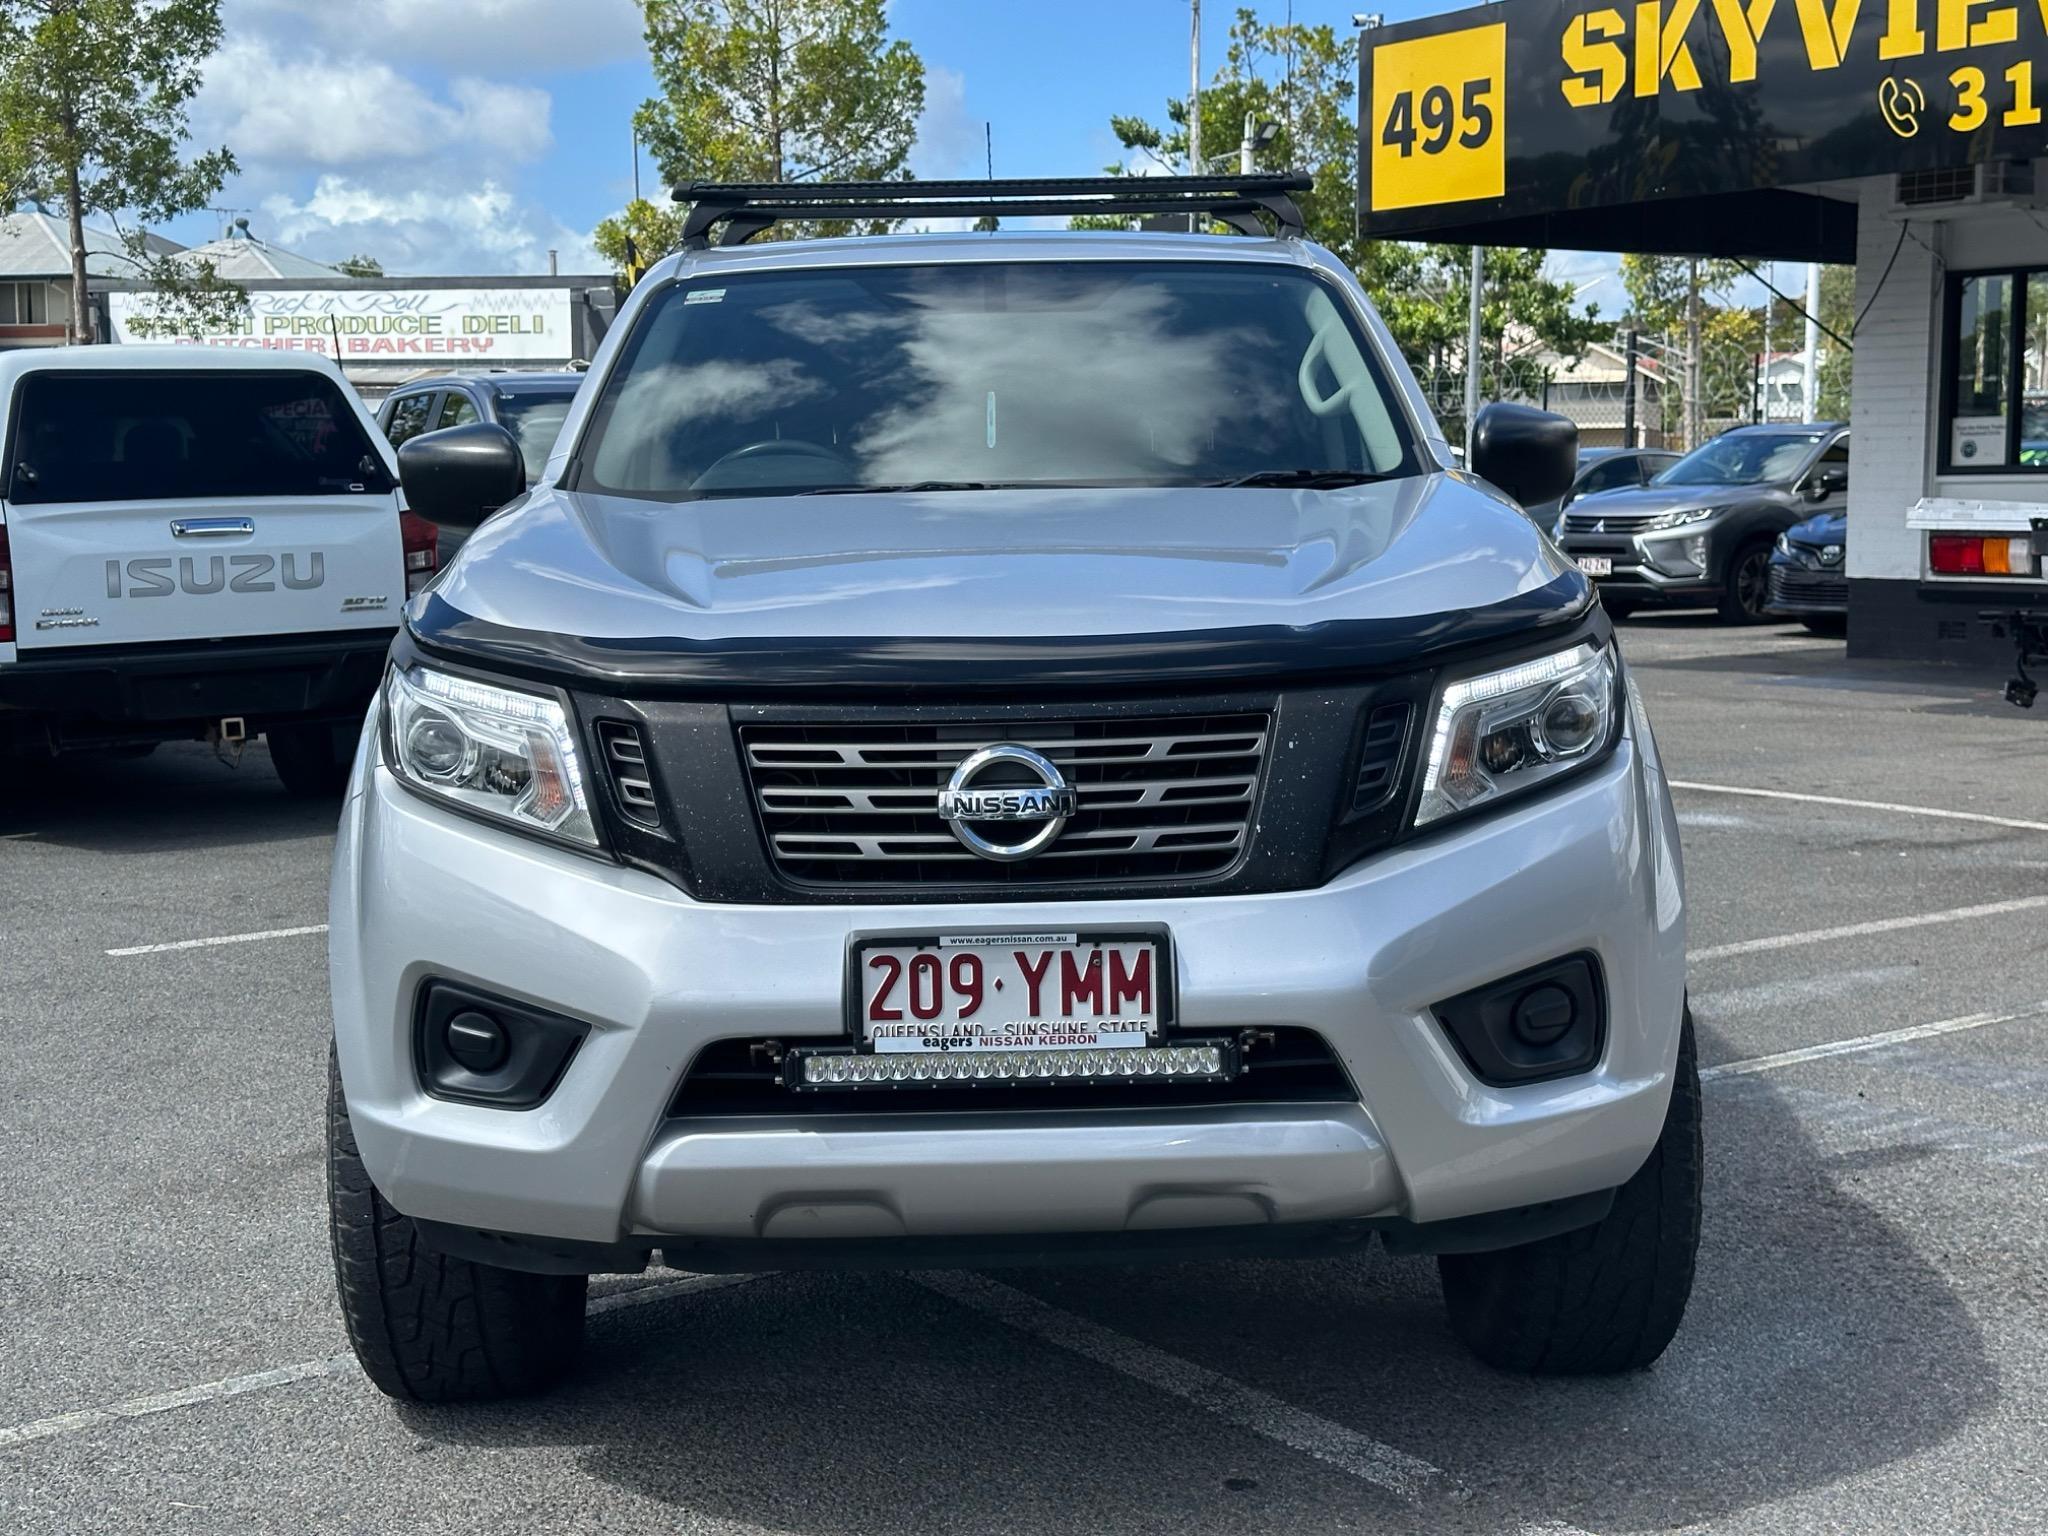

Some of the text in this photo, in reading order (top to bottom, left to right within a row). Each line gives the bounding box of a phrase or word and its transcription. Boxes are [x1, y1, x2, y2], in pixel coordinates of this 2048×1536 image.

[1561, 0, 2048, 108] SKYVIE
[1382, 77, 1494, 159] 495
[251, 292, 312, 315] Rock
[342, 290, 440, 314] Roll
[128, 316, 253, 336] RESH
[348, 337, 494, 353] BAKERY
[105, 551, 325, 598] ISUZU
[953, 795, 1060, 815] NISSAN
[950, 935, 1068, 946] www.eagersnissan.com.au
[868, 948, 1152, 1021] 209 YMM
[872, 1023, 985, 1037] QUEENSLAND
[1003, 1021, 1089, 1036] SUNSHINE
[1097, 1019, 1149, 1033] STATE
[922, 1034, 1098, 1051] eagers NISSAN KEDRON
